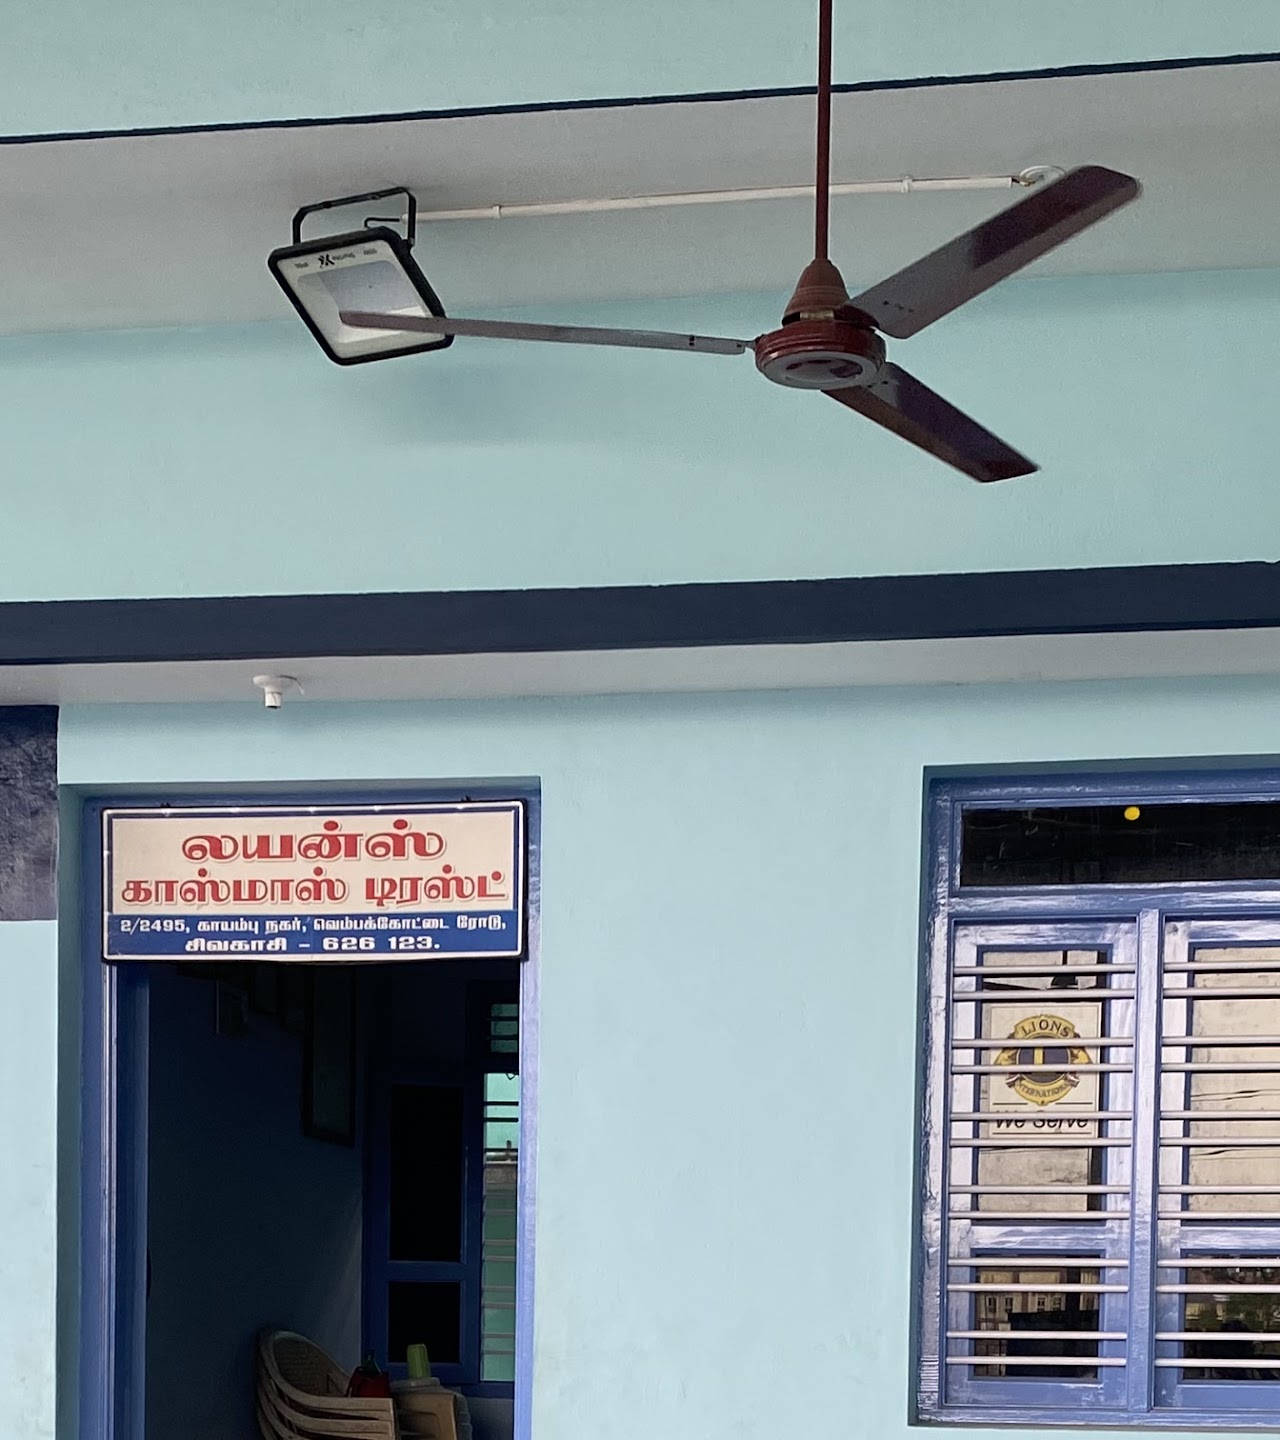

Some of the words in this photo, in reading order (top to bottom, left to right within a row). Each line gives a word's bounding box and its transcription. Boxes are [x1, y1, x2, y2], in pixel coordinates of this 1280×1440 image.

[180, 818, 446, 862] லயன்ஸ்
[120, 866, 348, 904] காஸ்மாஸ்
[363, 863, 508, 906] டிரஸ்ட்
[120, 917, 191, 935] 2/2495,
[264, 917, 307, 935] நகர்,
[456, 914, 507, 930] ரோடு,
[184, 937, 288, 952] சிவகாசி
[322, 937, 376, 950] 626
[387, 935, 441, 950] 123.
[1022, 1019, 1070, 1037] LIONS
